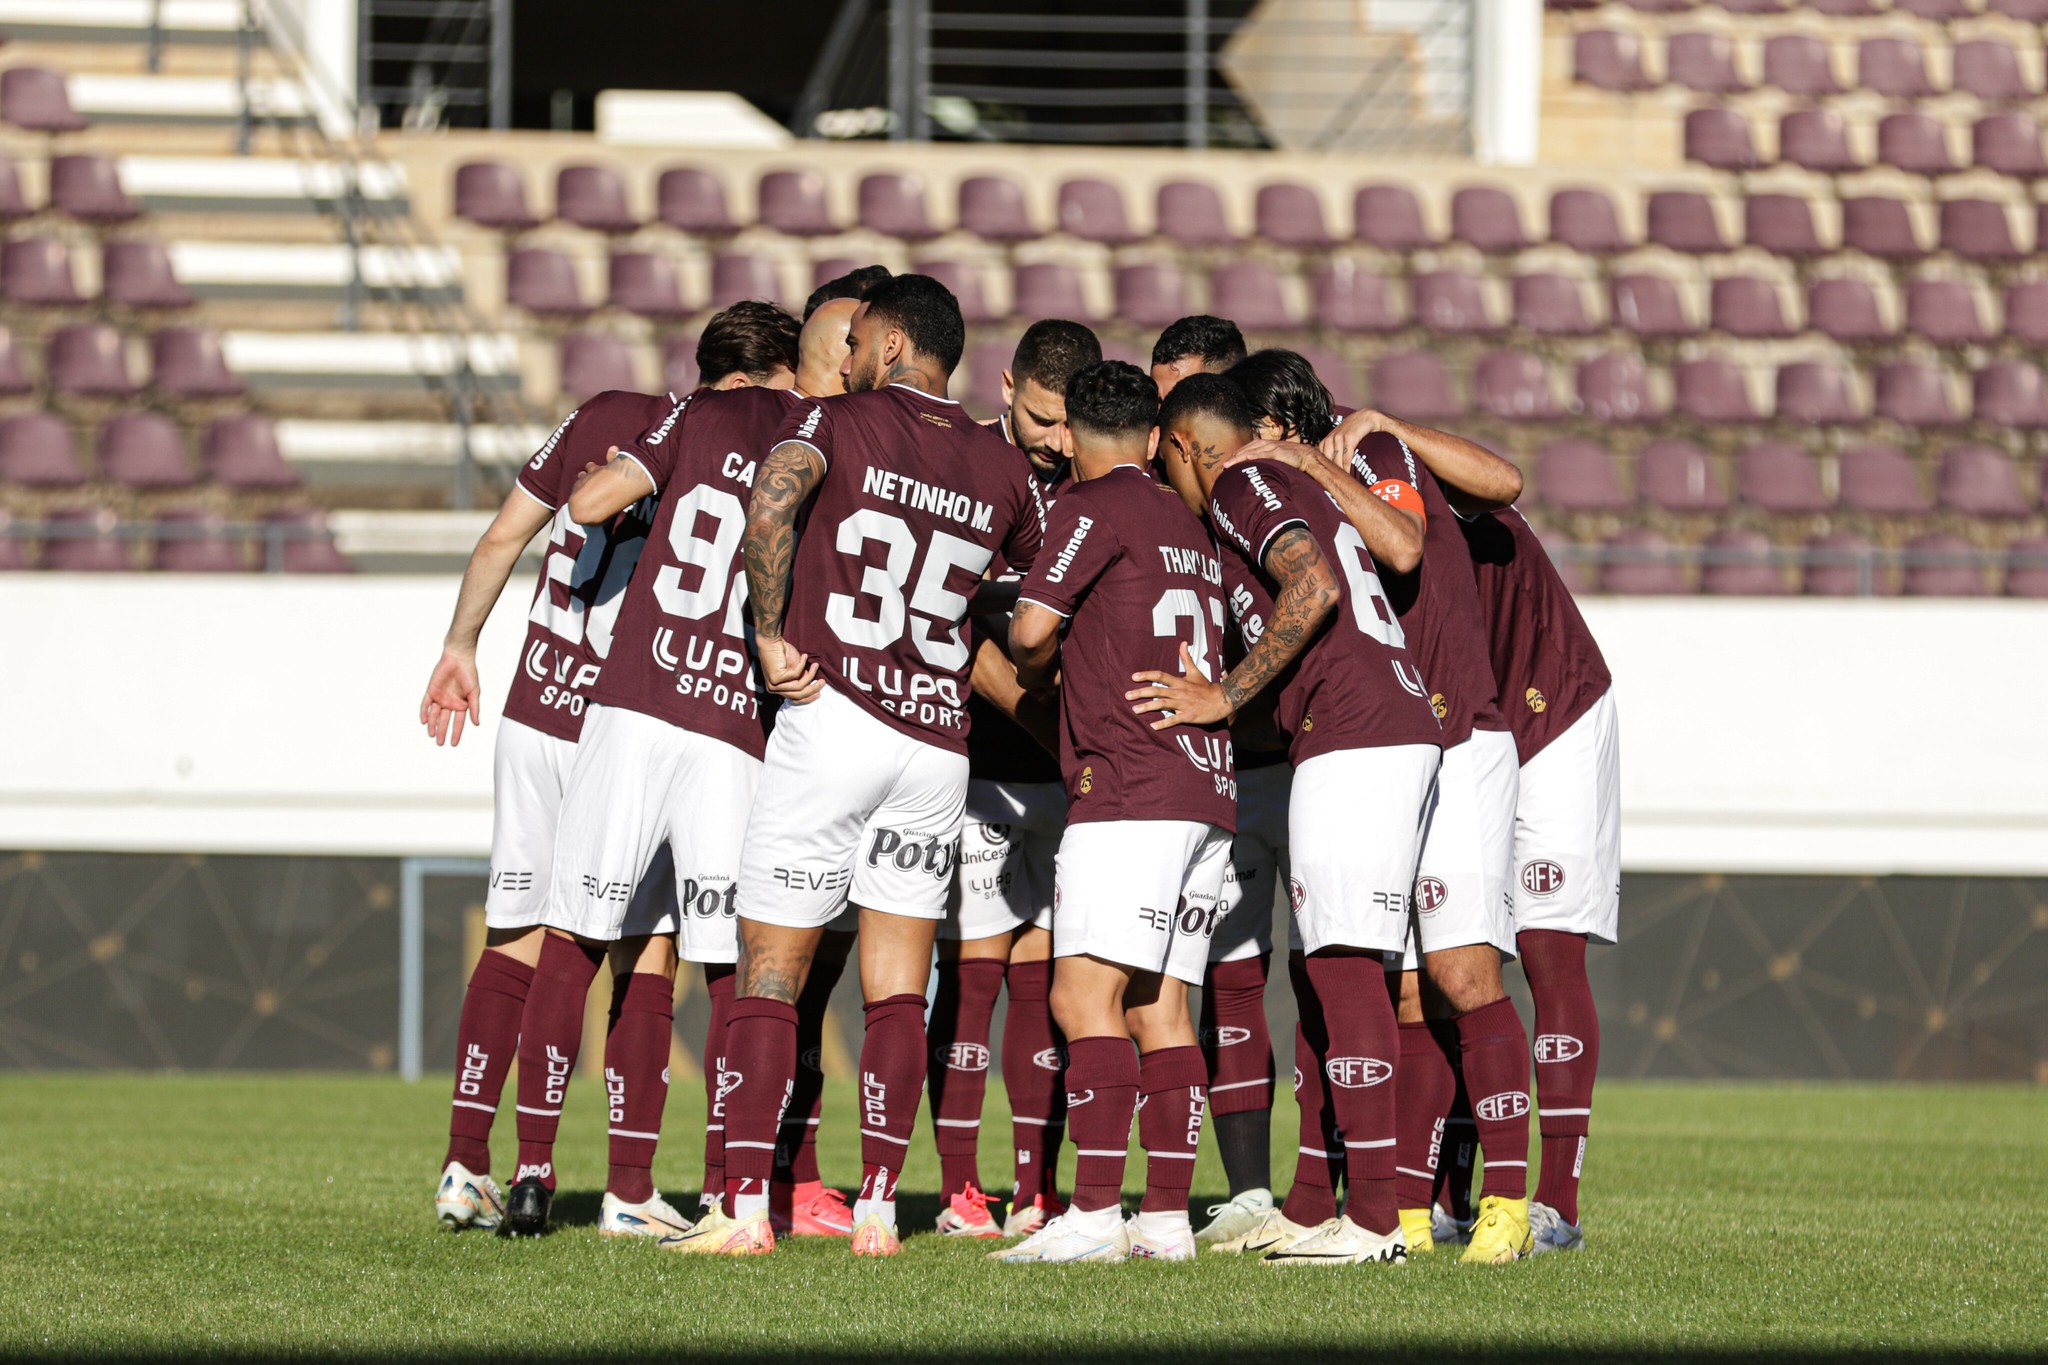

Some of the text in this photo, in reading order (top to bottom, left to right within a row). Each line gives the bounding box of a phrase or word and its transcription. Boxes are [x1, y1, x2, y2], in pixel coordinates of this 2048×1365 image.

[862, 466, 994, 534] NETINHO M.
[1046, 516, 1094, 583] Unimed
[825, 508, 994, 672] 35
[525, 639, 601, 690] LUP
[842, 656, 963, 708] LUPO
[540, 685, 586, 717] SPO
[676, 673, 764, 720] SPORT
[881, 699, 964, 730] SPORT
[1175, 734, 1234, 773] LUP
[1214, 773, 1237, 803] SPO
[865, 827, 960, 881] Poty
[1523, 863, 1560, 891] AFE
[682, 878, 738, 921] Pot
[1416, 881, 1443, 910] AFE
[460, 1043, 489, 1096] LUPO
[1328, 1060, 1381, 1084] AFE
[1535, 1037, 1572, 1061] AFE
[546, 1044, 569, 1104] LUPO
[605, 1067, 625, 1123] LUPO
[864, 1071, 887, 1127] LUPO
[1186, 1085, 1206, 1146] LUPO
[1480, 1093, 1525, 1118] AFE
